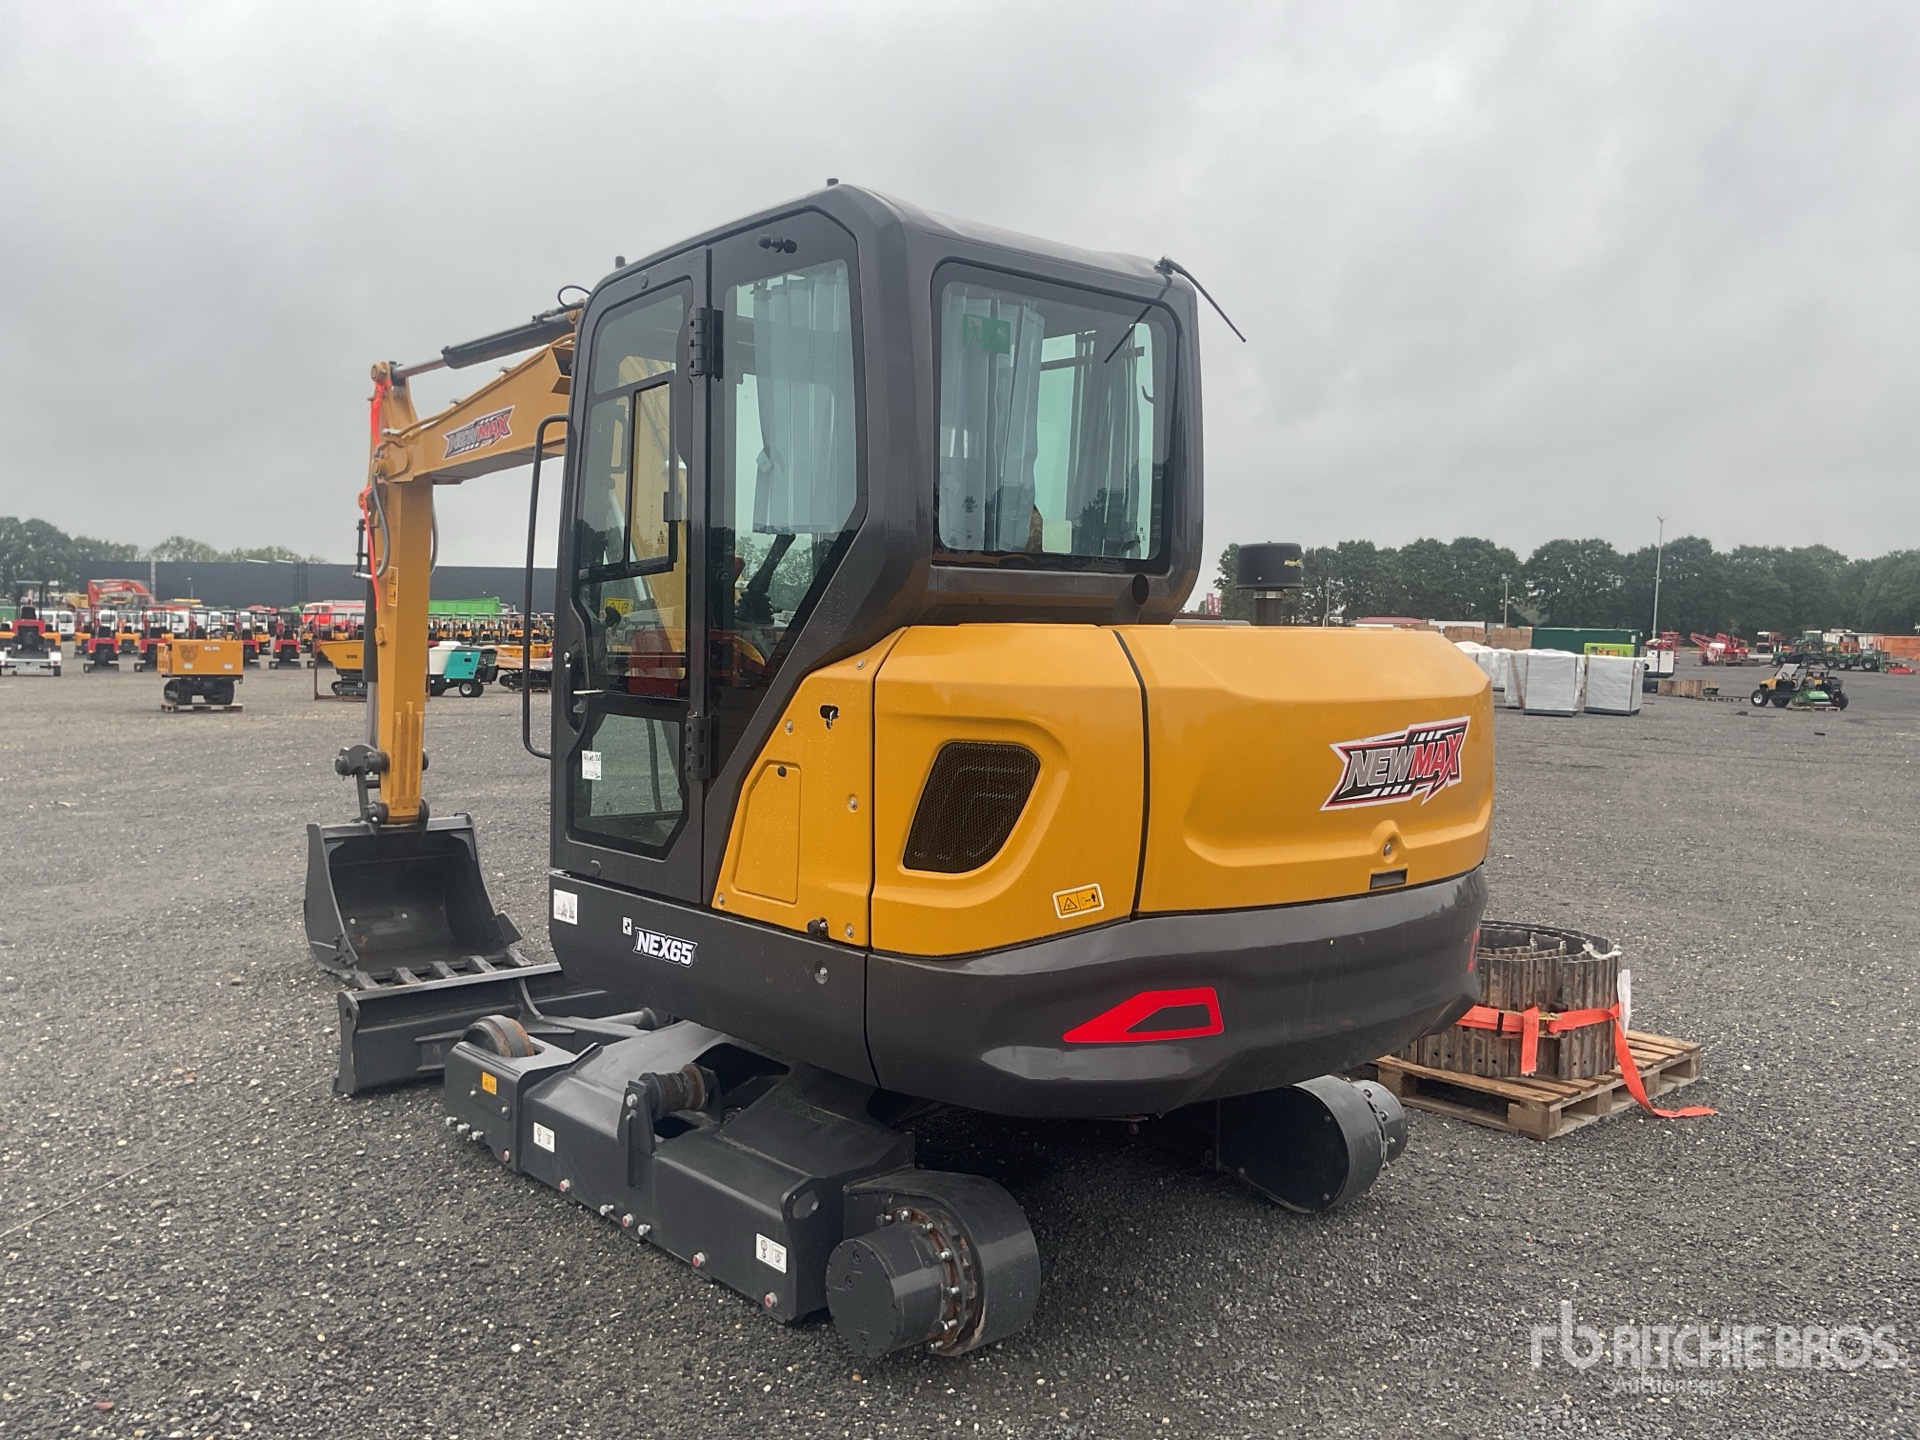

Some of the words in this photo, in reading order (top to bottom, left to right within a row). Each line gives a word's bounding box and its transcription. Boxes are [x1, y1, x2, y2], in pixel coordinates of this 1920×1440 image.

[447, 413, 510, 454] NEWMAX
[1338, 732, 1464, 796] NEWMAX
[636, 930, 694, 966] NEX65
